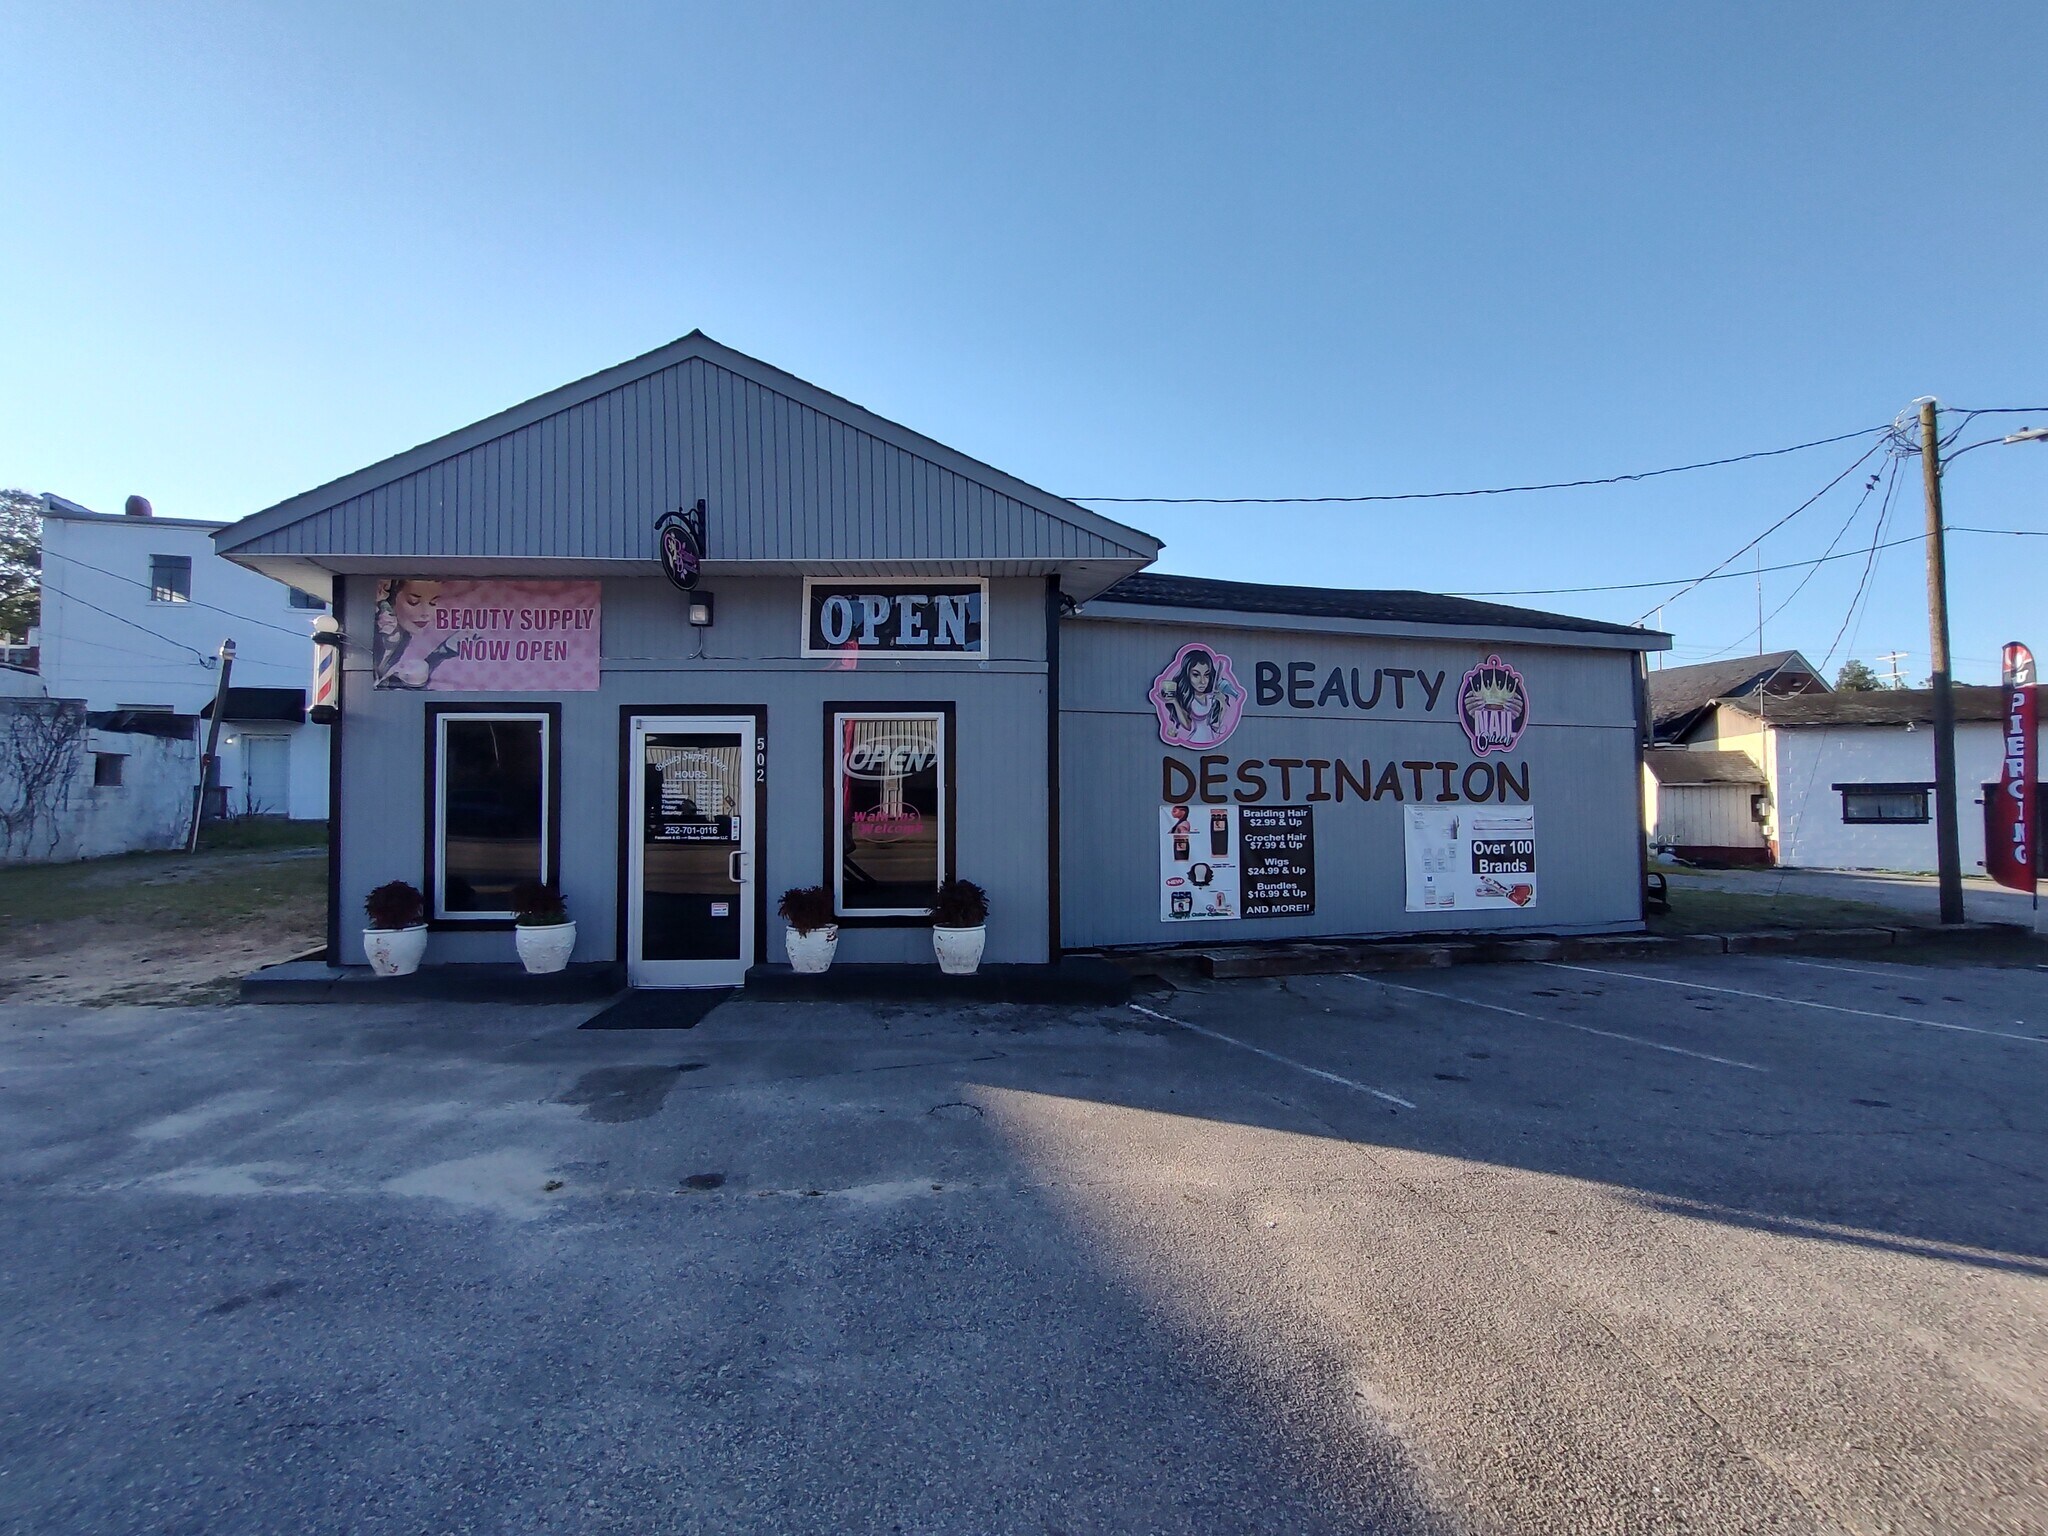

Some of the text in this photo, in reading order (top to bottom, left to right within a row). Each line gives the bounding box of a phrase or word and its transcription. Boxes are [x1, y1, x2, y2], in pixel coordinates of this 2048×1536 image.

[435, 608, 594, 631] BEAUTY SUPPLY
[820, 594, 969, 645] OPEN
[459, 640, 568, 661] NOW OPEN
[1255, 661, 1446, 712] BEAUTY
[1474, 710, 1517, 737] NAIL
[682, 751, 709, 764] Supply
[710, 756, 728, 773] Store
[757, 737, 765, 782] 502
[849, 744, 930, 772] OPEN
[674, 770, 708, 778] HOURS
[1162, 755, 1530, 803] DESTINATION
[2006, 692, 2027, 865] PIERCING
[1243, 809, 1308, 818] Braiding Hair
[1250, 818, 1302, 827] $2.99 & Up
[665, 826, 718, 835] 252-701-0116
[1244, 833, 1307, 842] Crochet Hair
[1250, 841, 1303, 850] $7.99 & Up
[1473, 840, 1532, 855] Over 100
[1264, 858, 1289, 867] Wigs
[1479, 858, 1527, 872] Brands
[1247, 867, 1279, 876] $24.99
[1292, 866, 1306, 875] Up
[1167, 878, 1183, 886] NEW
[1257, 882, 1297, 890] Bundles
[1247, 890, 1279, 899] $16.99
[1292, 889, 1307, 898] Up
[1246, 904, 1310, 914] AND MORE!!
